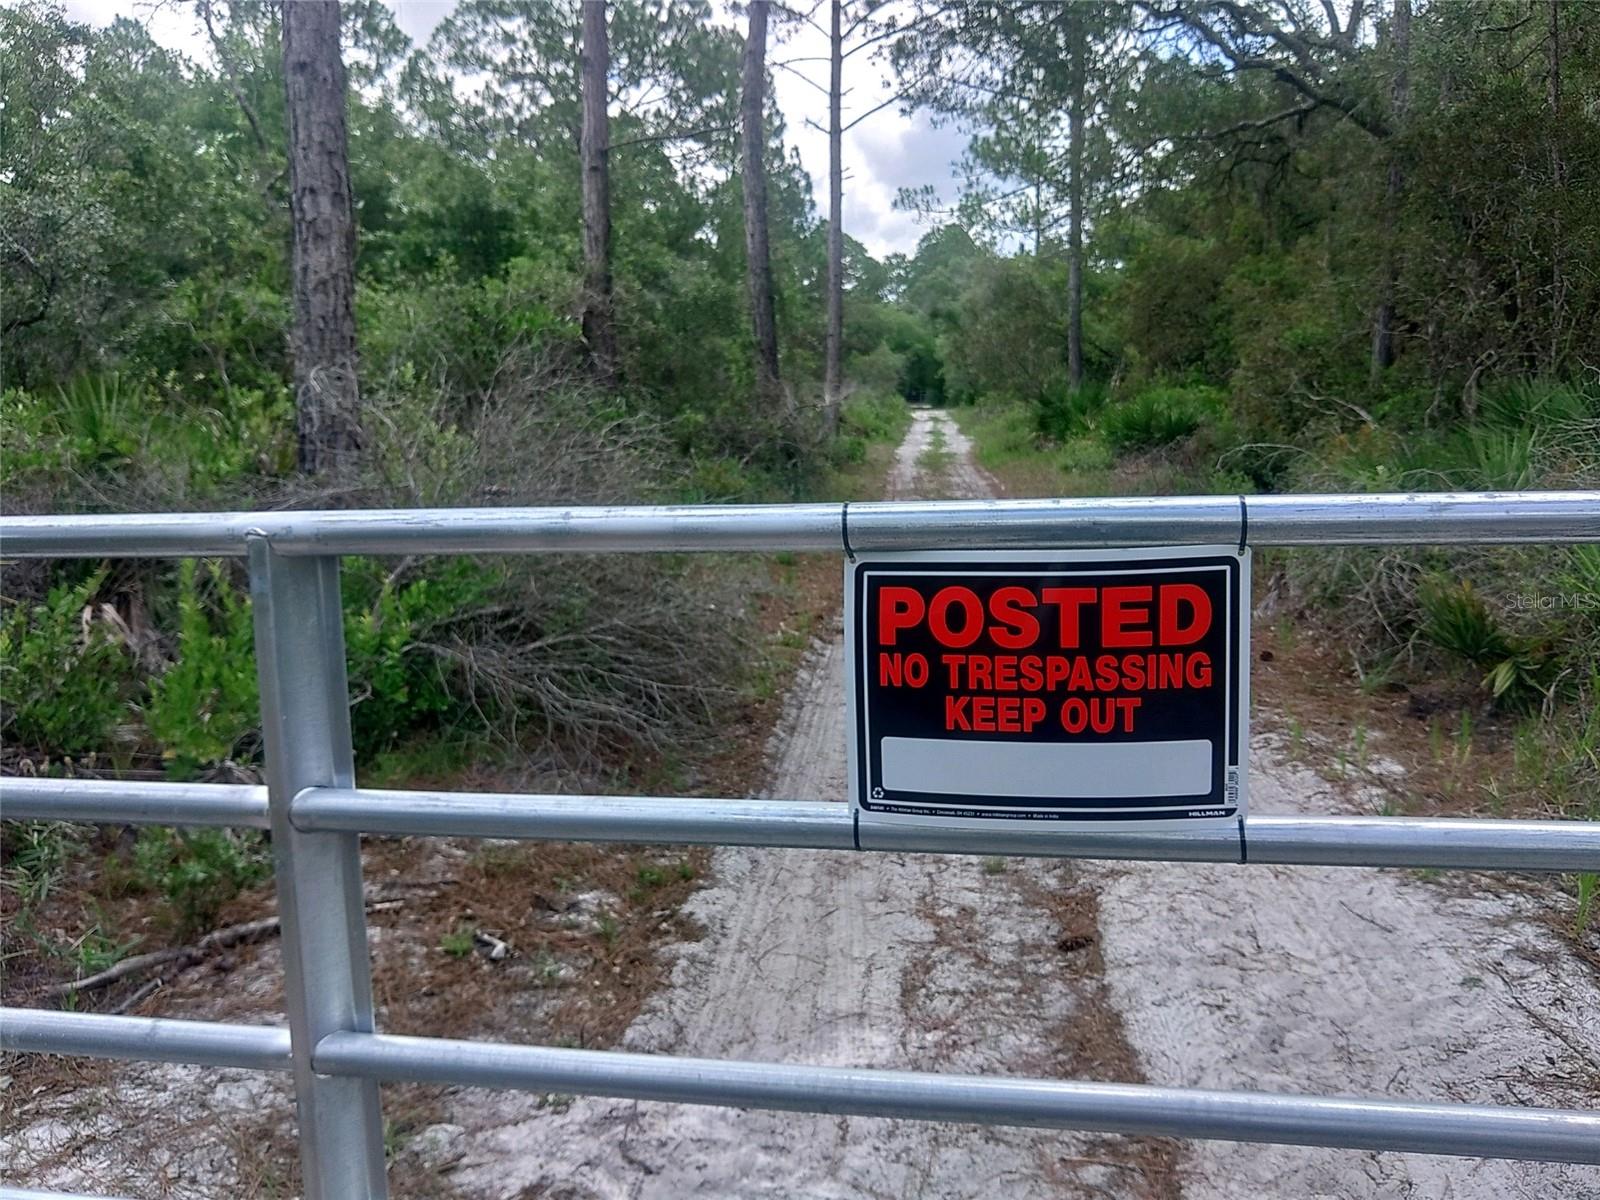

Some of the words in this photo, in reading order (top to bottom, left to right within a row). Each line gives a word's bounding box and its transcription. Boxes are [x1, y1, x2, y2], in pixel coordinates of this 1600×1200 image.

[879, 583, 1213, 649] POSTED
[879, 652, 929, 688] NO
[942, 651, 1213, 692] TRESPASSING
[945, 695, 1047, 733] KEEP
[1060, 697, 1142, 734] OUT
